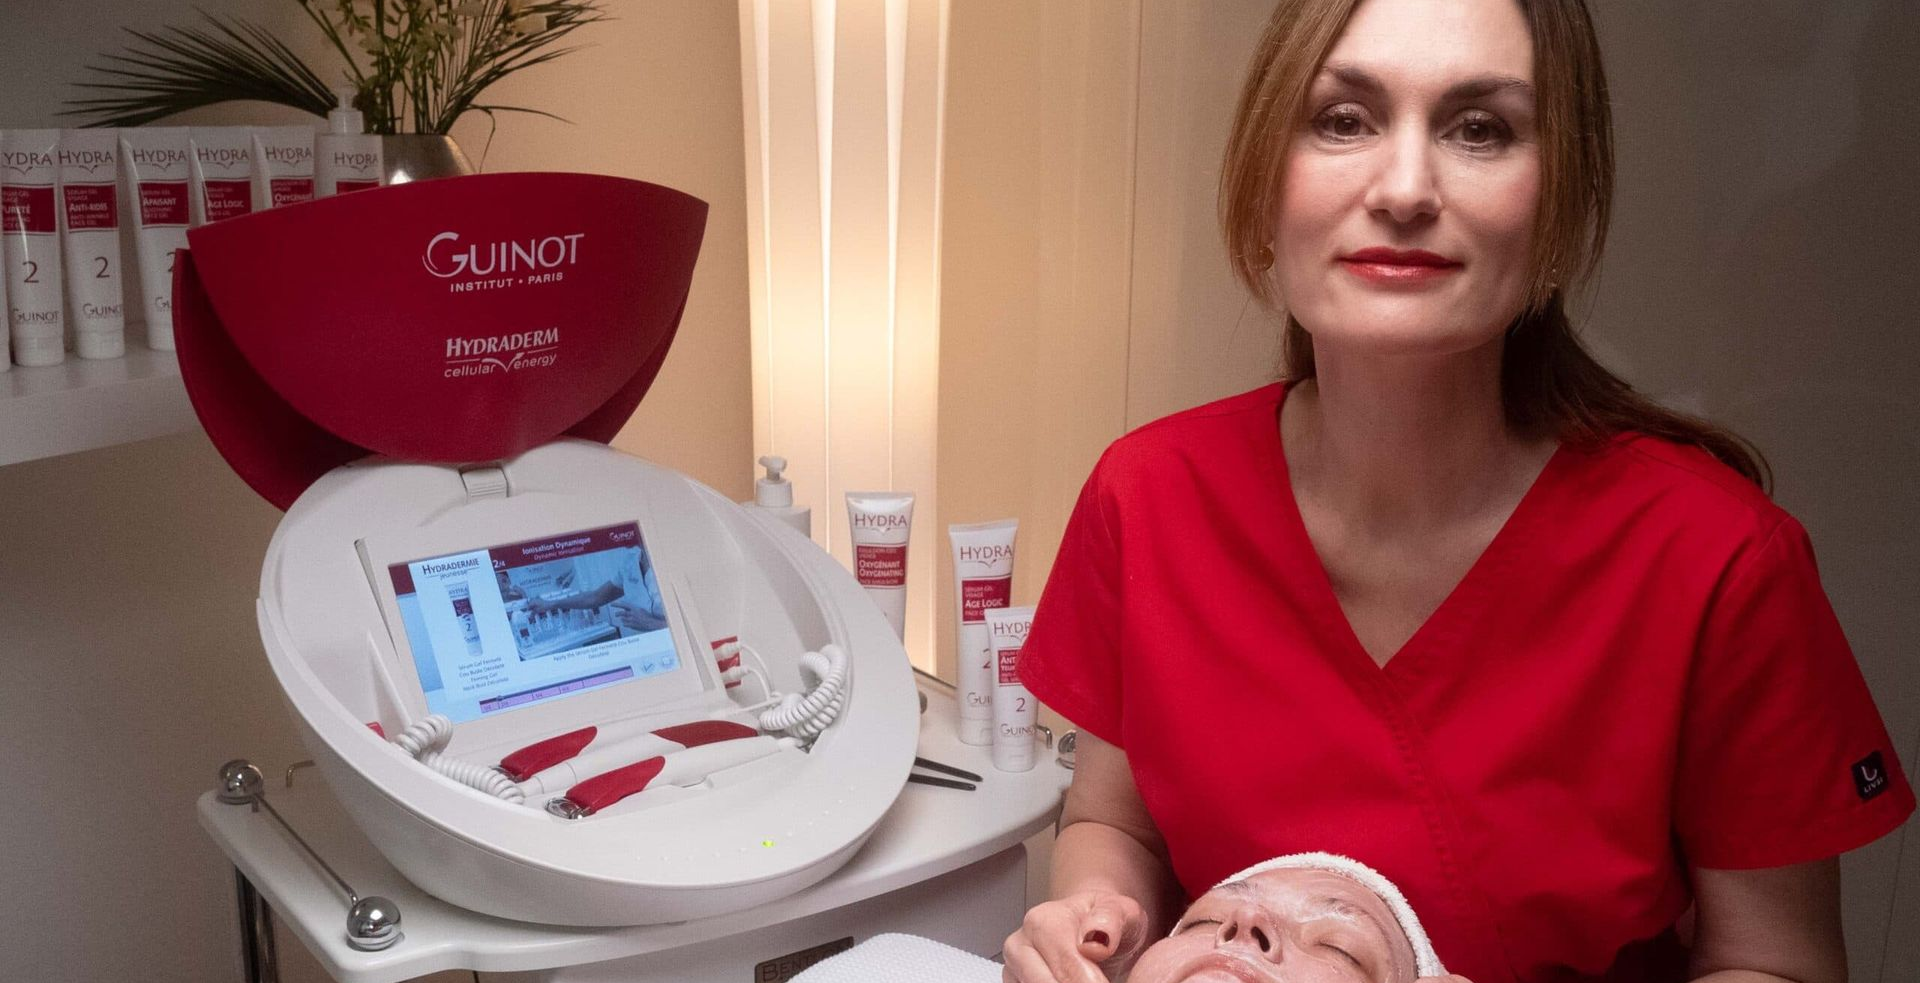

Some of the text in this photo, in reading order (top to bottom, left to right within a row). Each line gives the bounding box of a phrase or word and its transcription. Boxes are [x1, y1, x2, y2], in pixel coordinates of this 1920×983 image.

[3, 151, 53, 166] YDRA
[58, 150, 114, 164] HYDRA
[133, 149, 187, 162] HYDRA
[197, 147, 249, 161] HYDRA
[265, 146, 313, 160] HYDRA
[334, 152, 379, 165] HYDRA
[4, 203, 31, 214] URETÉ
[143, 197, 176, 206] APAISANT
[223, 199, 244, 208] LOGIC
[422, 231, 585, 278] GUINOT
[22, 260, 39, 283] 2
[95, 256, 110, 278] 2
[450, 272, 564, 292] INSTITUT PARIS
[13, 307, 59, 322] GUINOT
[83, 303, 122, 316] GUINO
[446, 327, 559, 358] HYDRADERM
[444, 353, 557, 378] cellular energy
[855, 513, 908, 527] HYDRA
[521, 537, 591, 555] Ionisation Dynamique
[960, 544, 1013, 560] HYDRA
[422, 558, 480, 575] HYDRADERMIE
[965, 598, 1004, 609] AGE LOGIC
[466, 623, 472, 631] 2
[994, 621, 1032, 635] HYDR
[1000, 656, 1016, 664] ANT
[967, 691, 992, 705] GUI
[1016, 697, 1026, 712] 2
